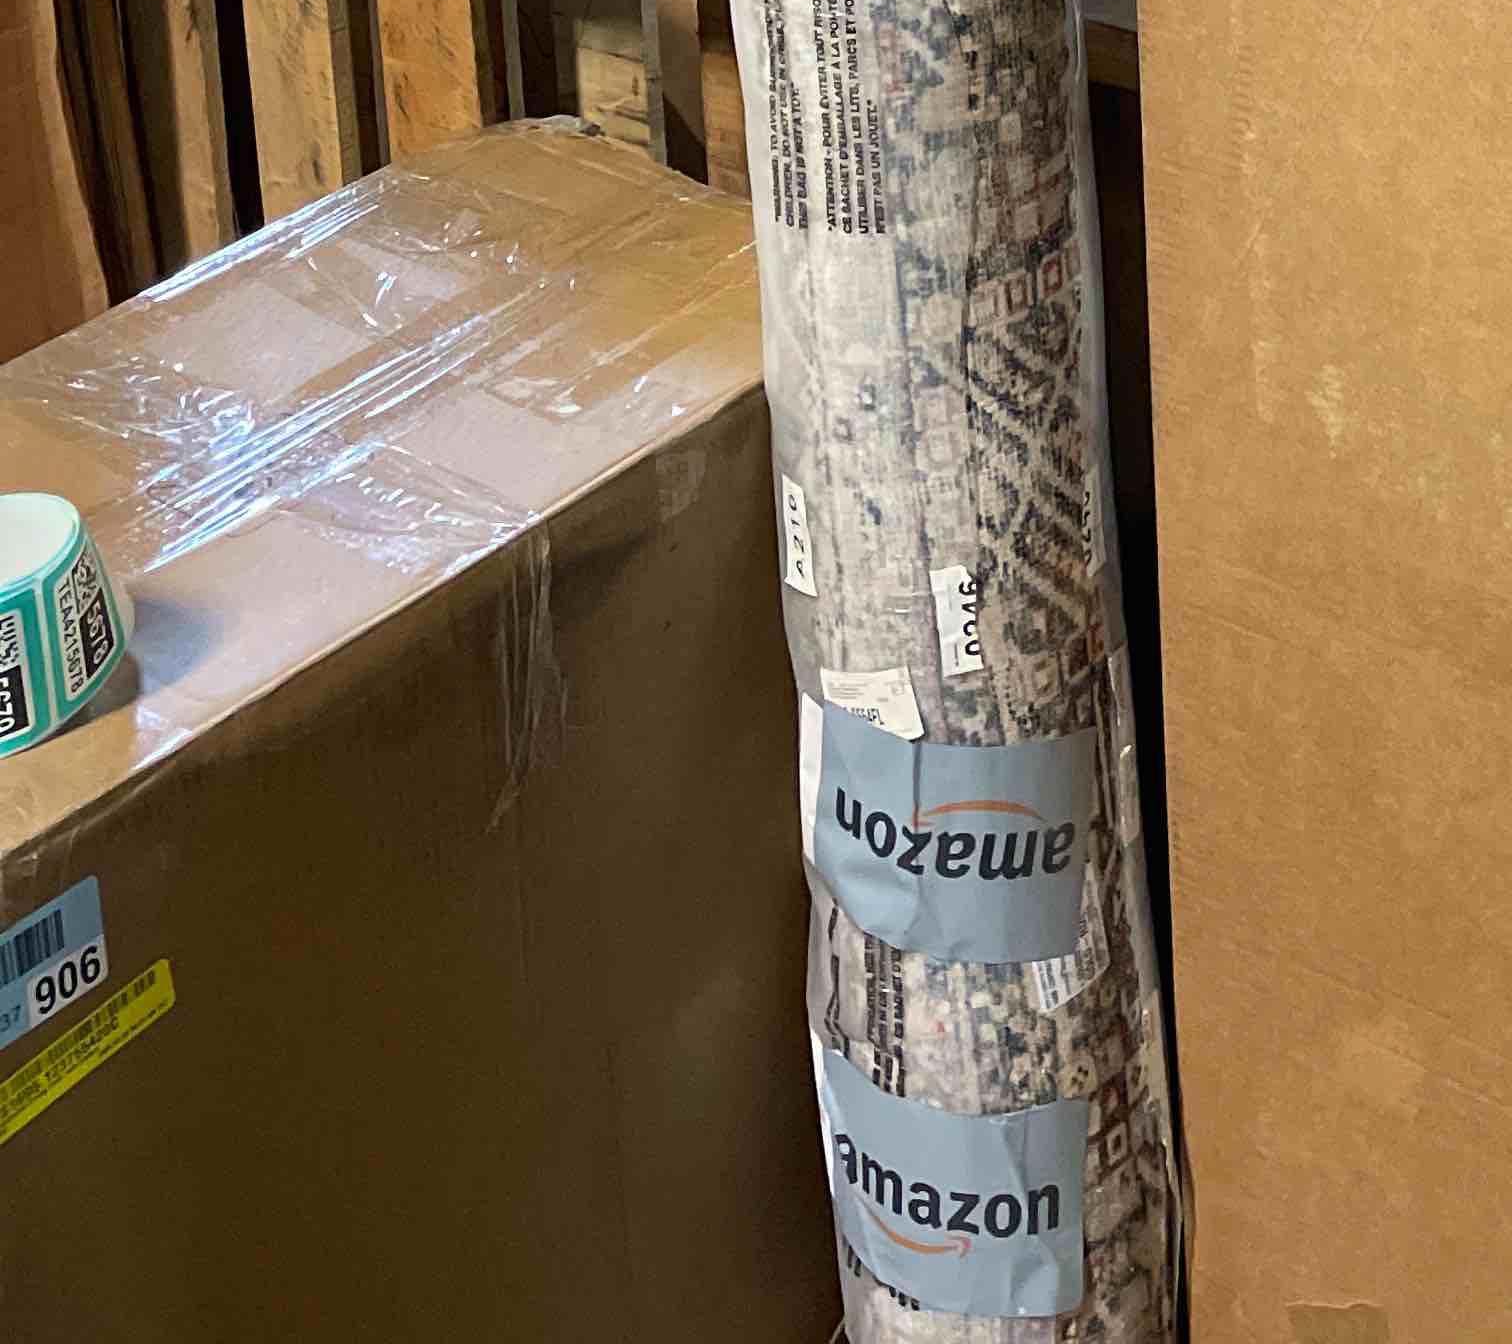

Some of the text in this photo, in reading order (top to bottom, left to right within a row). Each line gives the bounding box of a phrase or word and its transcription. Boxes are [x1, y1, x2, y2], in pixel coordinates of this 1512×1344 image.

[846, 21, 856, 34] ET
[814, 30, 825, 62] TOUT
[830, 42, 840, 58] LA
[847, 38, 859, 79] PARCS
[821, 113, 832, 147] POUR
[870, 151, 880, 168] UN
[797, 172, 807, 199] BAG
[839, 163, 851, 213] SACHET
[871, 172, 882, 195] PAS
[843, 217, 852, 234] CE
[57, 577, 85, 694] TEA4215678
[86, 599, 109, 664] 5678
[835, 786, 1076, 881] amazon
[35, 945, 101, 1015] 906
[834, 1133, 1061, 1239] amazon
